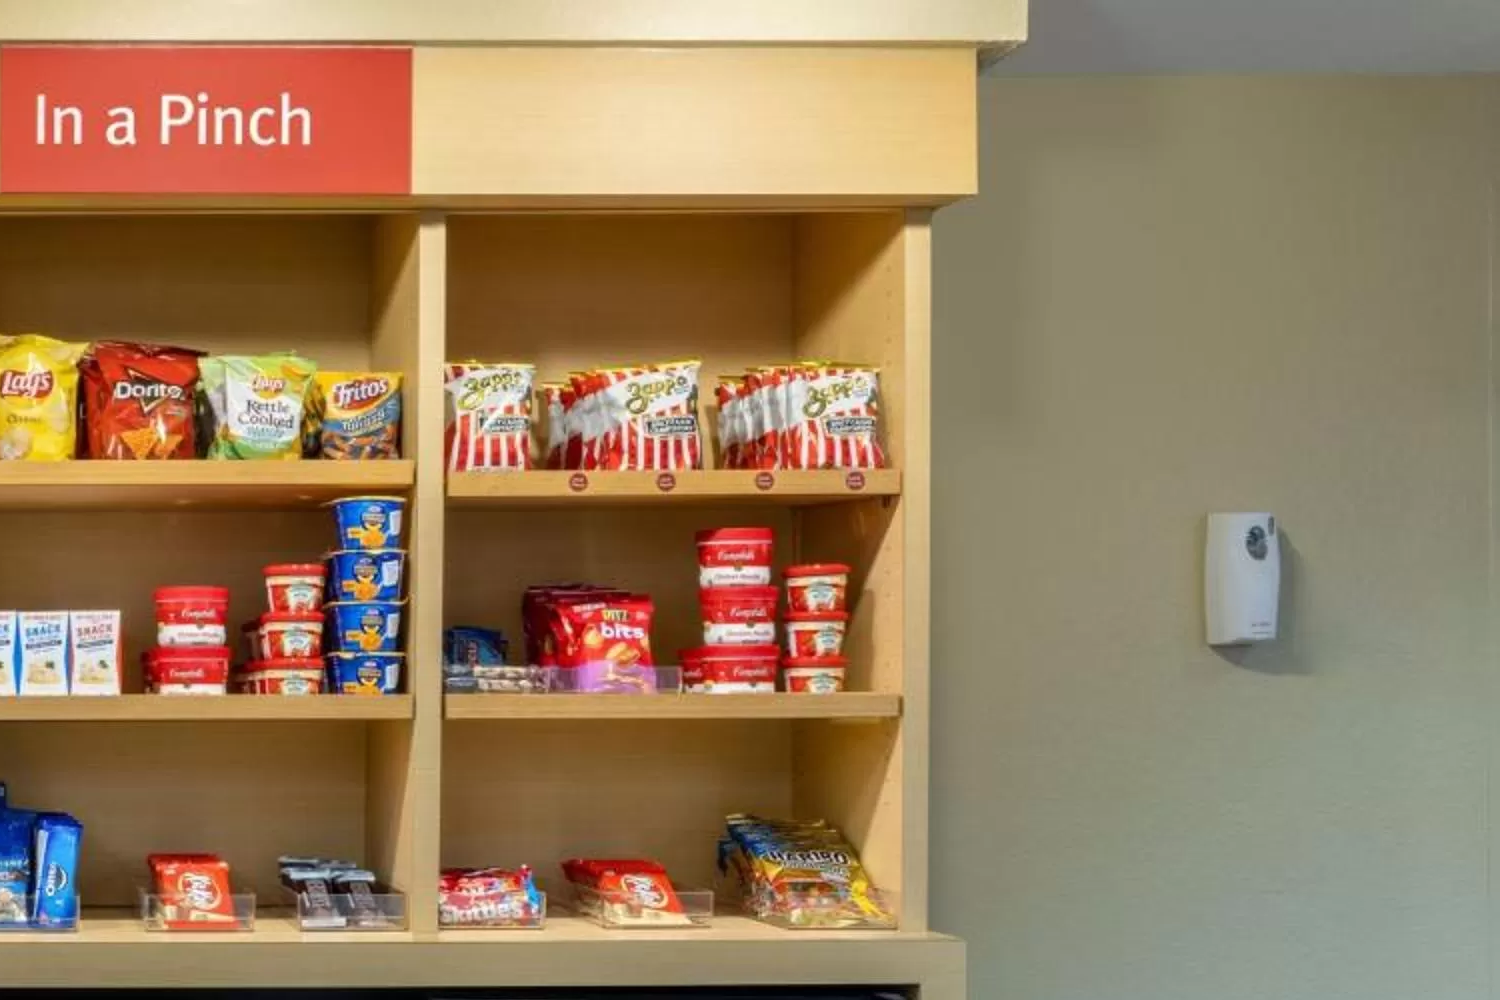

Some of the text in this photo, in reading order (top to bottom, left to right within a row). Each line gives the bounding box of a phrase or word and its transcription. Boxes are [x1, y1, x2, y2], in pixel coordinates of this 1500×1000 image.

[36, 91, 313, 146] In a Pinch
[2, 370, 52, 399] Lay's
[335, 378, 390, 405] Fritos
[245, 399, 290, 413] Kettle
[238, 410, 295, 430] Cooked
[77, 623, 113, 636] SNACK
[600, 621, 645, 640] bits
[767, 849, 851, 865] HARIBO
